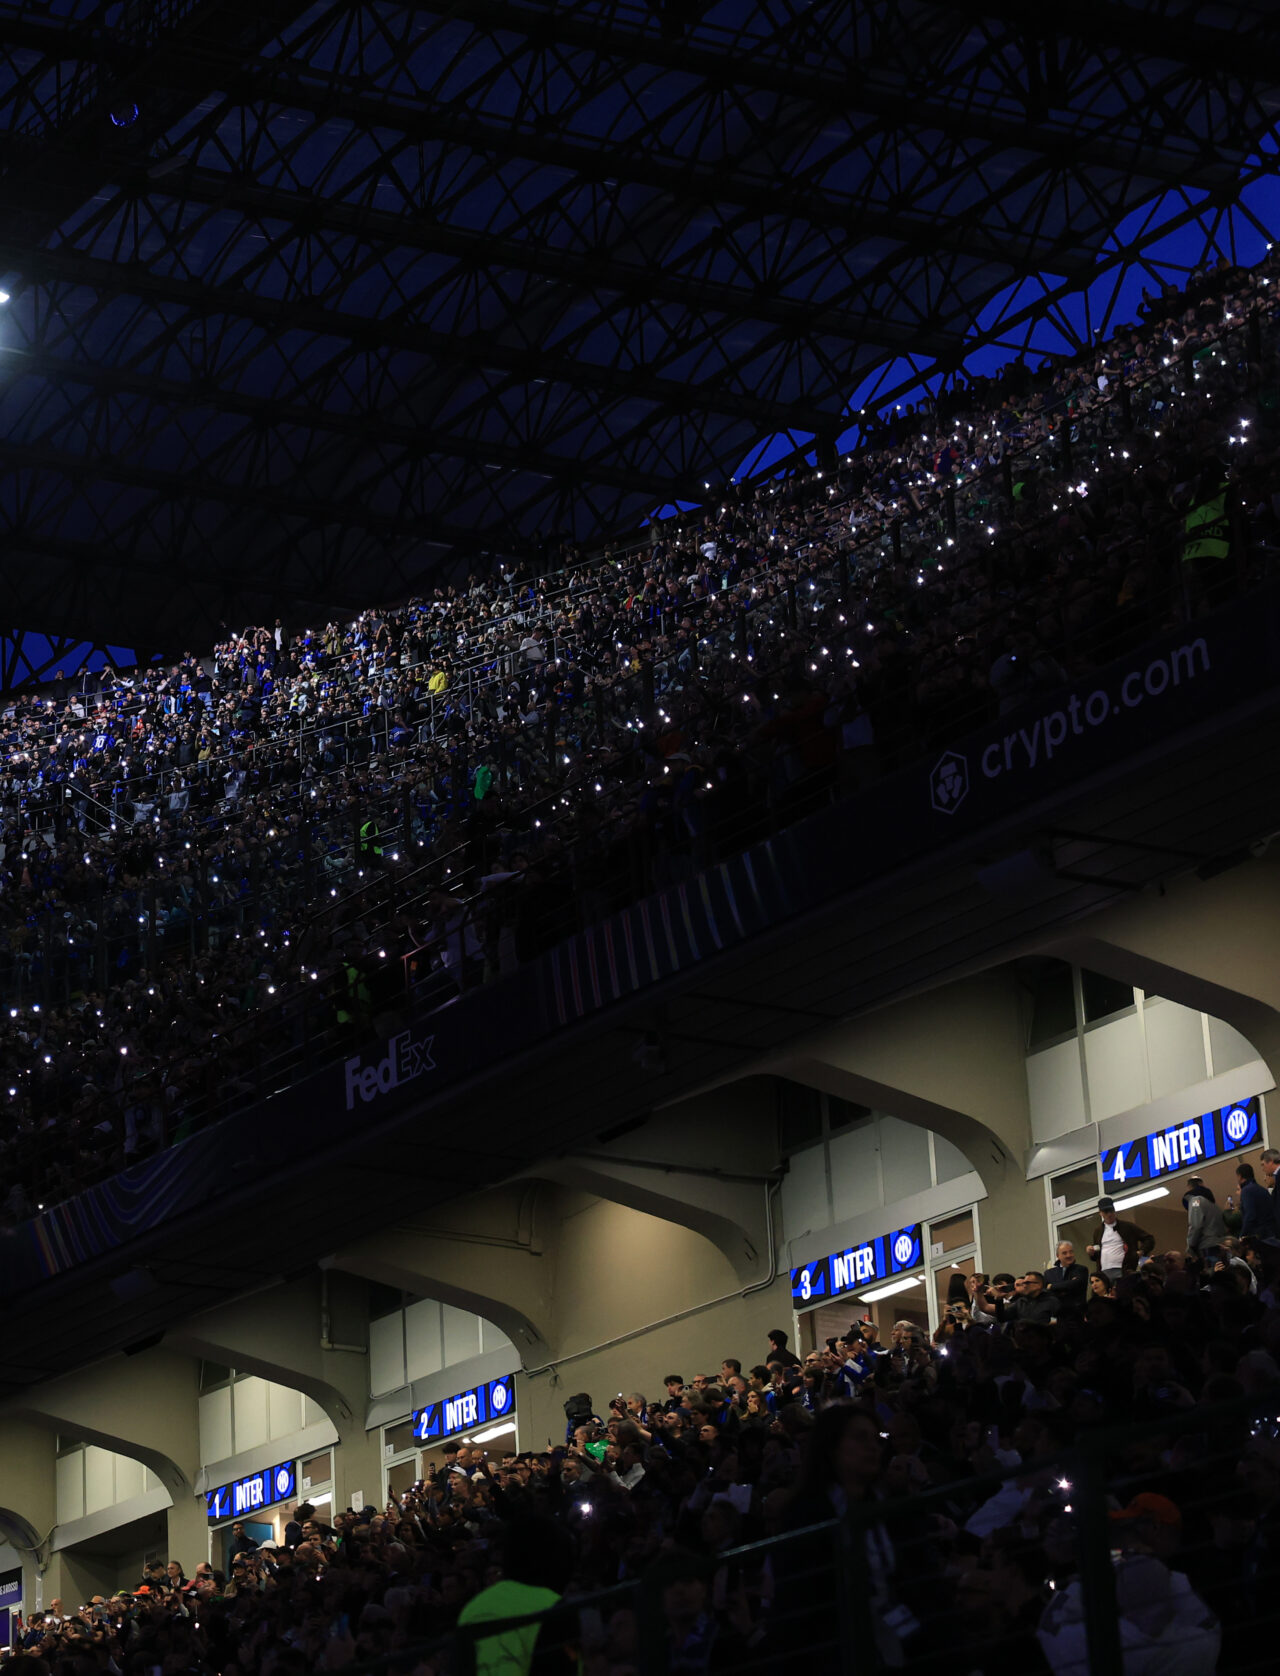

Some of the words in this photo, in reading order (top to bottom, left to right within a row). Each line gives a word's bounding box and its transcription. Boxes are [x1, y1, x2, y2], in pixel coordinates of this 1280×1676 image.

[981, 637, 1211, 778] crypto.com
[344, 1029, 437, 1111] FedEx
[1114, 1151, 1126, 1182] 4
[1153, 1123, 1203, 1170] INTER
[800, 1269, 811, 1300] 3
[834, 1246, 875, 1288] INTER
[420, 1412, 429, 1440] 2
[446, 1393, 477, 1430] INTER
[214, 1493, 219, 1519] 1
[236, 1477, 263, 1511] INTER
